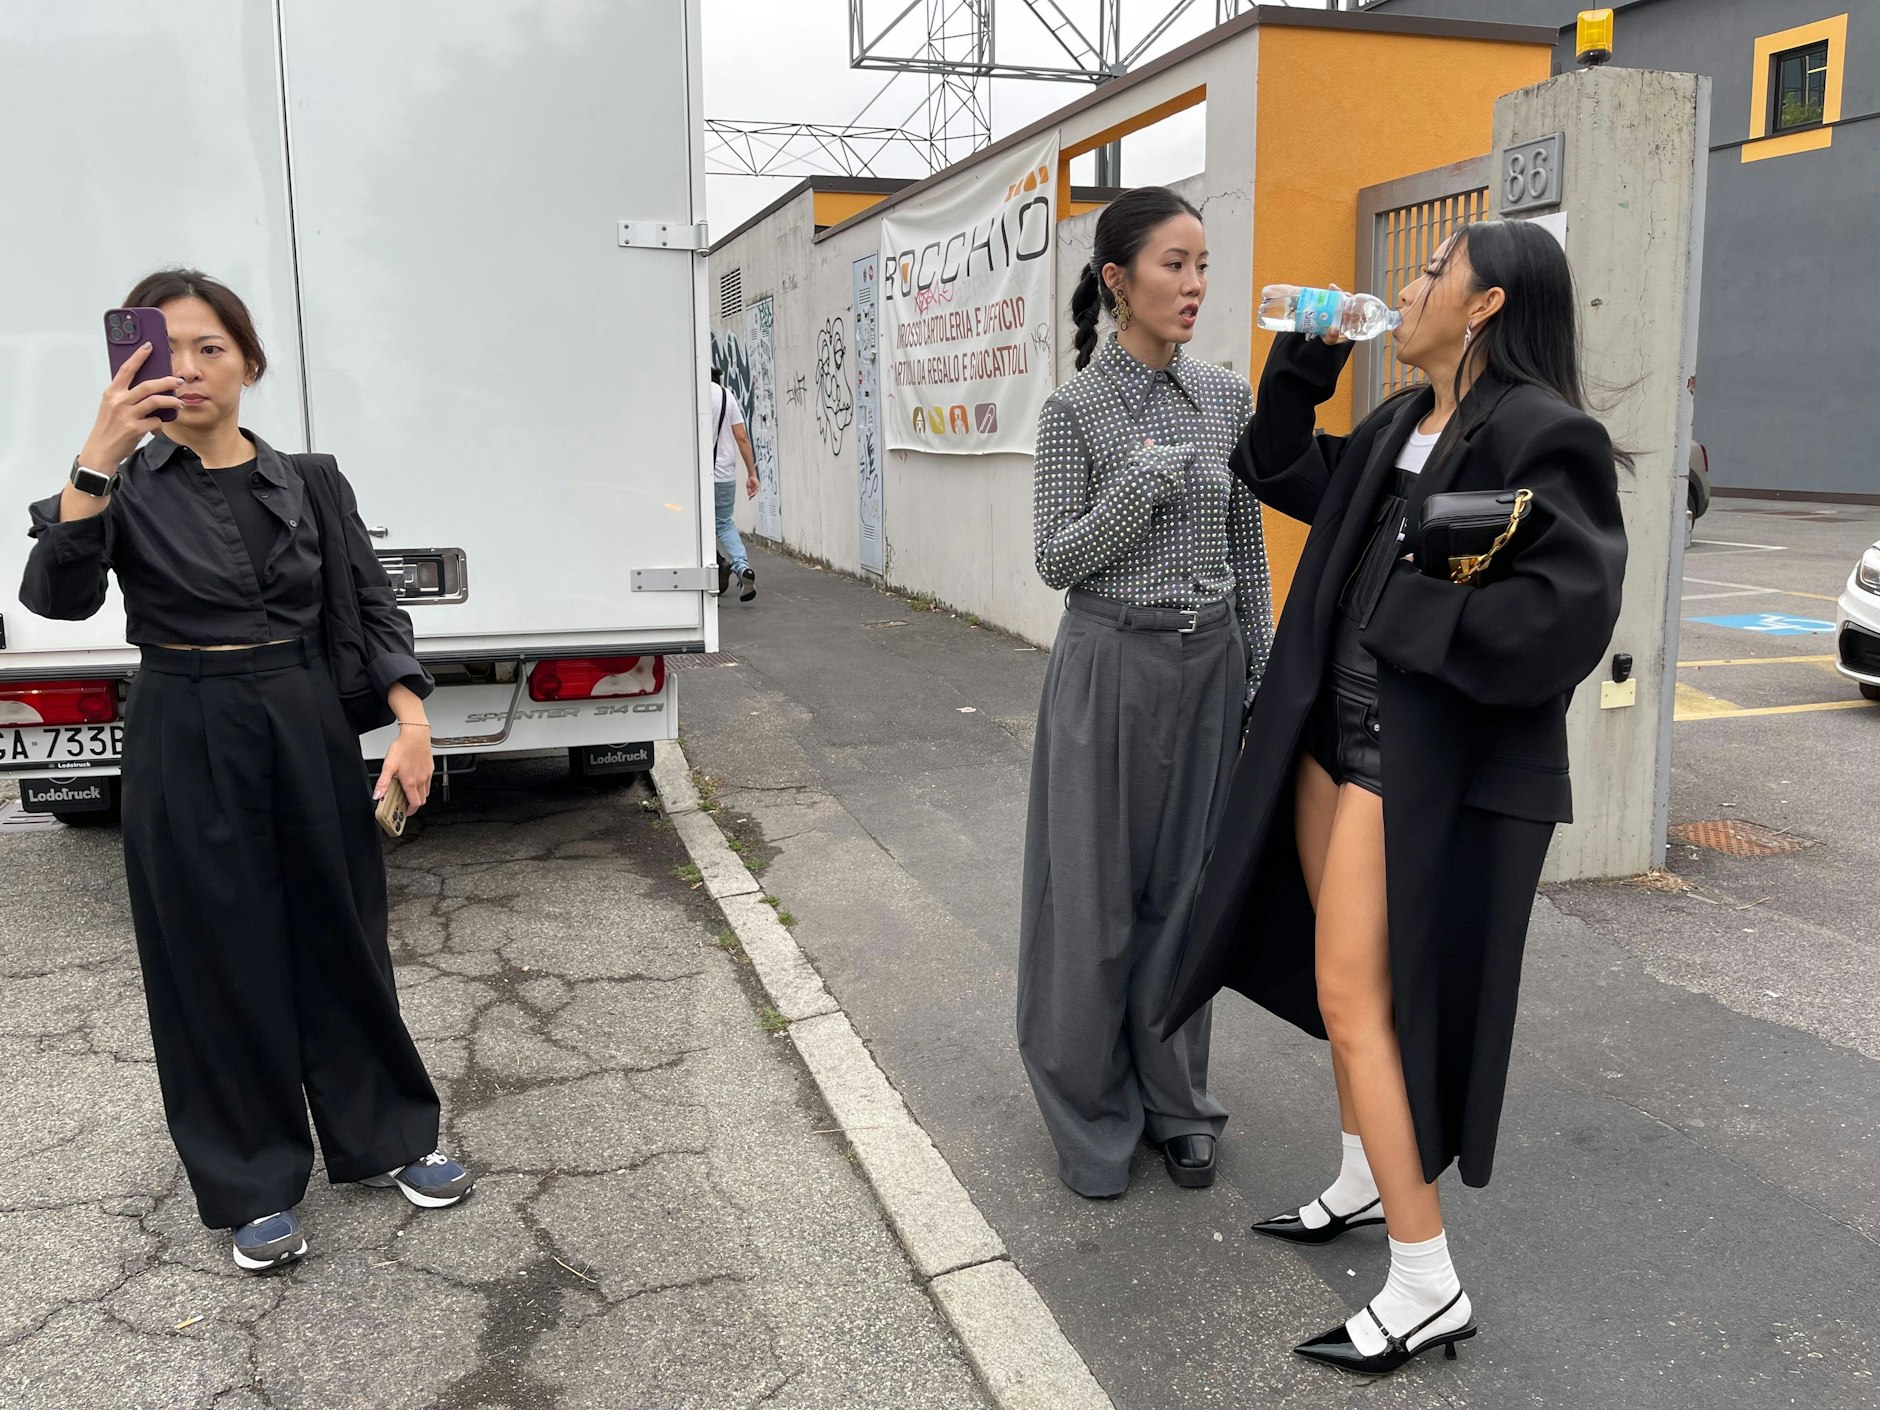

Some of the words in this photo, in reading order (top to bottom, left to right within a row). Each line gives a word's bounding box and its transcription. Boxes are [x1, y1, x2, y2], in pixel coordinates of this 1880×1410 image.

[1506, 148, 1548, 203] 86
[923, 309, 973, 345] CARTOLERIA
[975, 307, 982, 337] E
[983, 296, 1025, 335] UFFICIO
[917, 358, 927, 386] DA
[928, 354, 960, 385] REGALO
[962, 353, 968, 381] E
[969, 342, 1029, 381] GIOCATTOLI
[593, 704, 629, 715] 314
[632, 702, 665, 713] CDI
